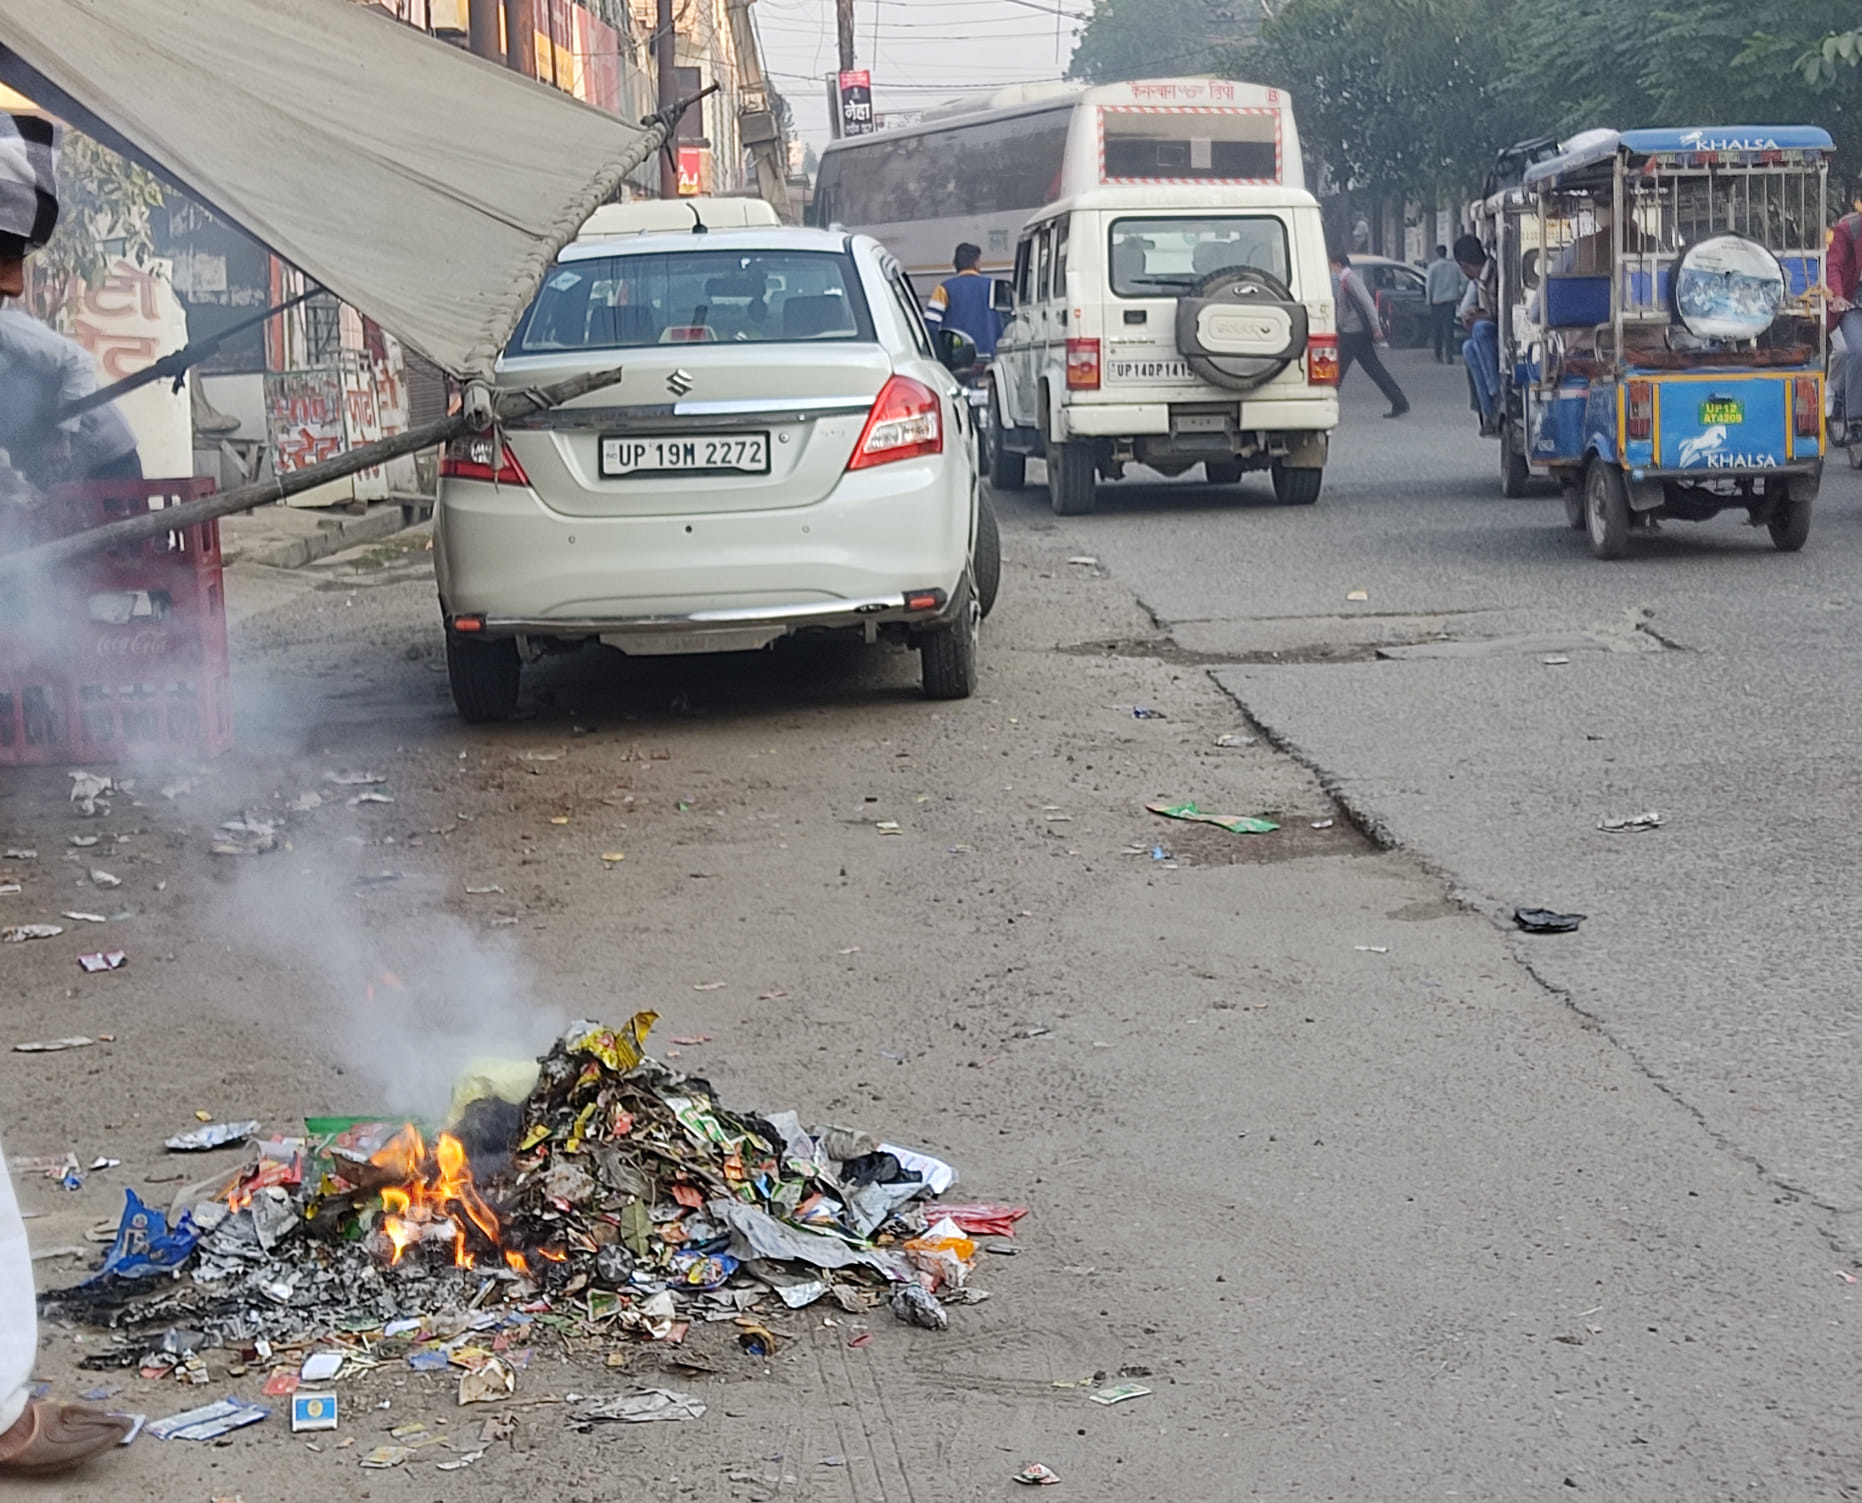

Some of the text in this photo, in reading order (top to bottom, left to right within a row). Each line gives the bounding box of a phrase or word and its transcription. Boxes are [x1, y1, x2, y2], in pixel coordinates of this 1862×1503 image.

[844, 99, 871, 121] नेहा
[1696, 138, 1779, 151] KHALSA
[619, 444, 646, 467] UP
[656, 442, 695, 467] 19M
[705, 441, 762, 465] 2272
[1706, 453, 1777, 469] KHALSA
